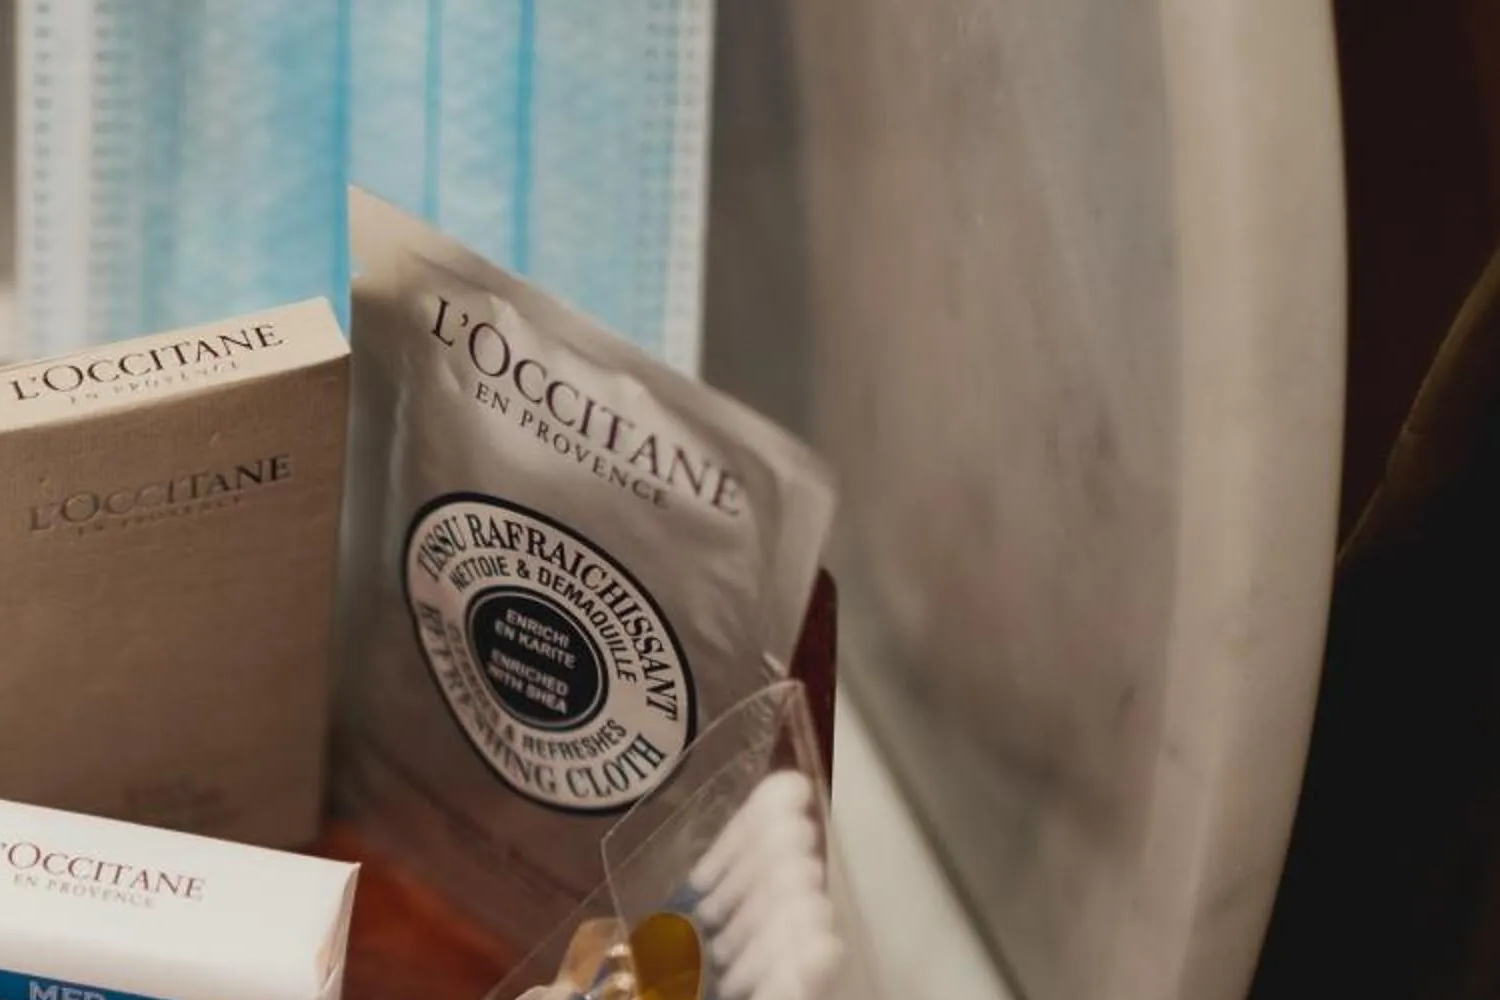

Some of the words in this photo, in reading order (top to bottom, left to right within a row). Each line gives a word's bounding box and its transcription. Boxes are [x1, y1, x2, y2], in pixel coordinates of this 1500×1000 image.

[10, 324, 284, 401] L'OCCITANE
[431, 296, 741, 516] L'OCCITANE
[474, 382, 509, 416] EN
[518, 409, 671, 511] PROVENCE
[29, 453, 293, 532] L'OCCITANE
[449, 555, 511, 593] NETTOIE
[516, 558, 531, 580] &
[416, 515, 467, 583] TISSU
[463, 512, 679, 722] RAFRAICHISSANT
[505, 607, 570, 649] ENRICHI
[522, 718, 628, 761] REFRESHES
[564, 732, 667, 799] CLOTH
[12, 872, 39, 888] EN
[46, 878, 157, 910] PROVENCE
